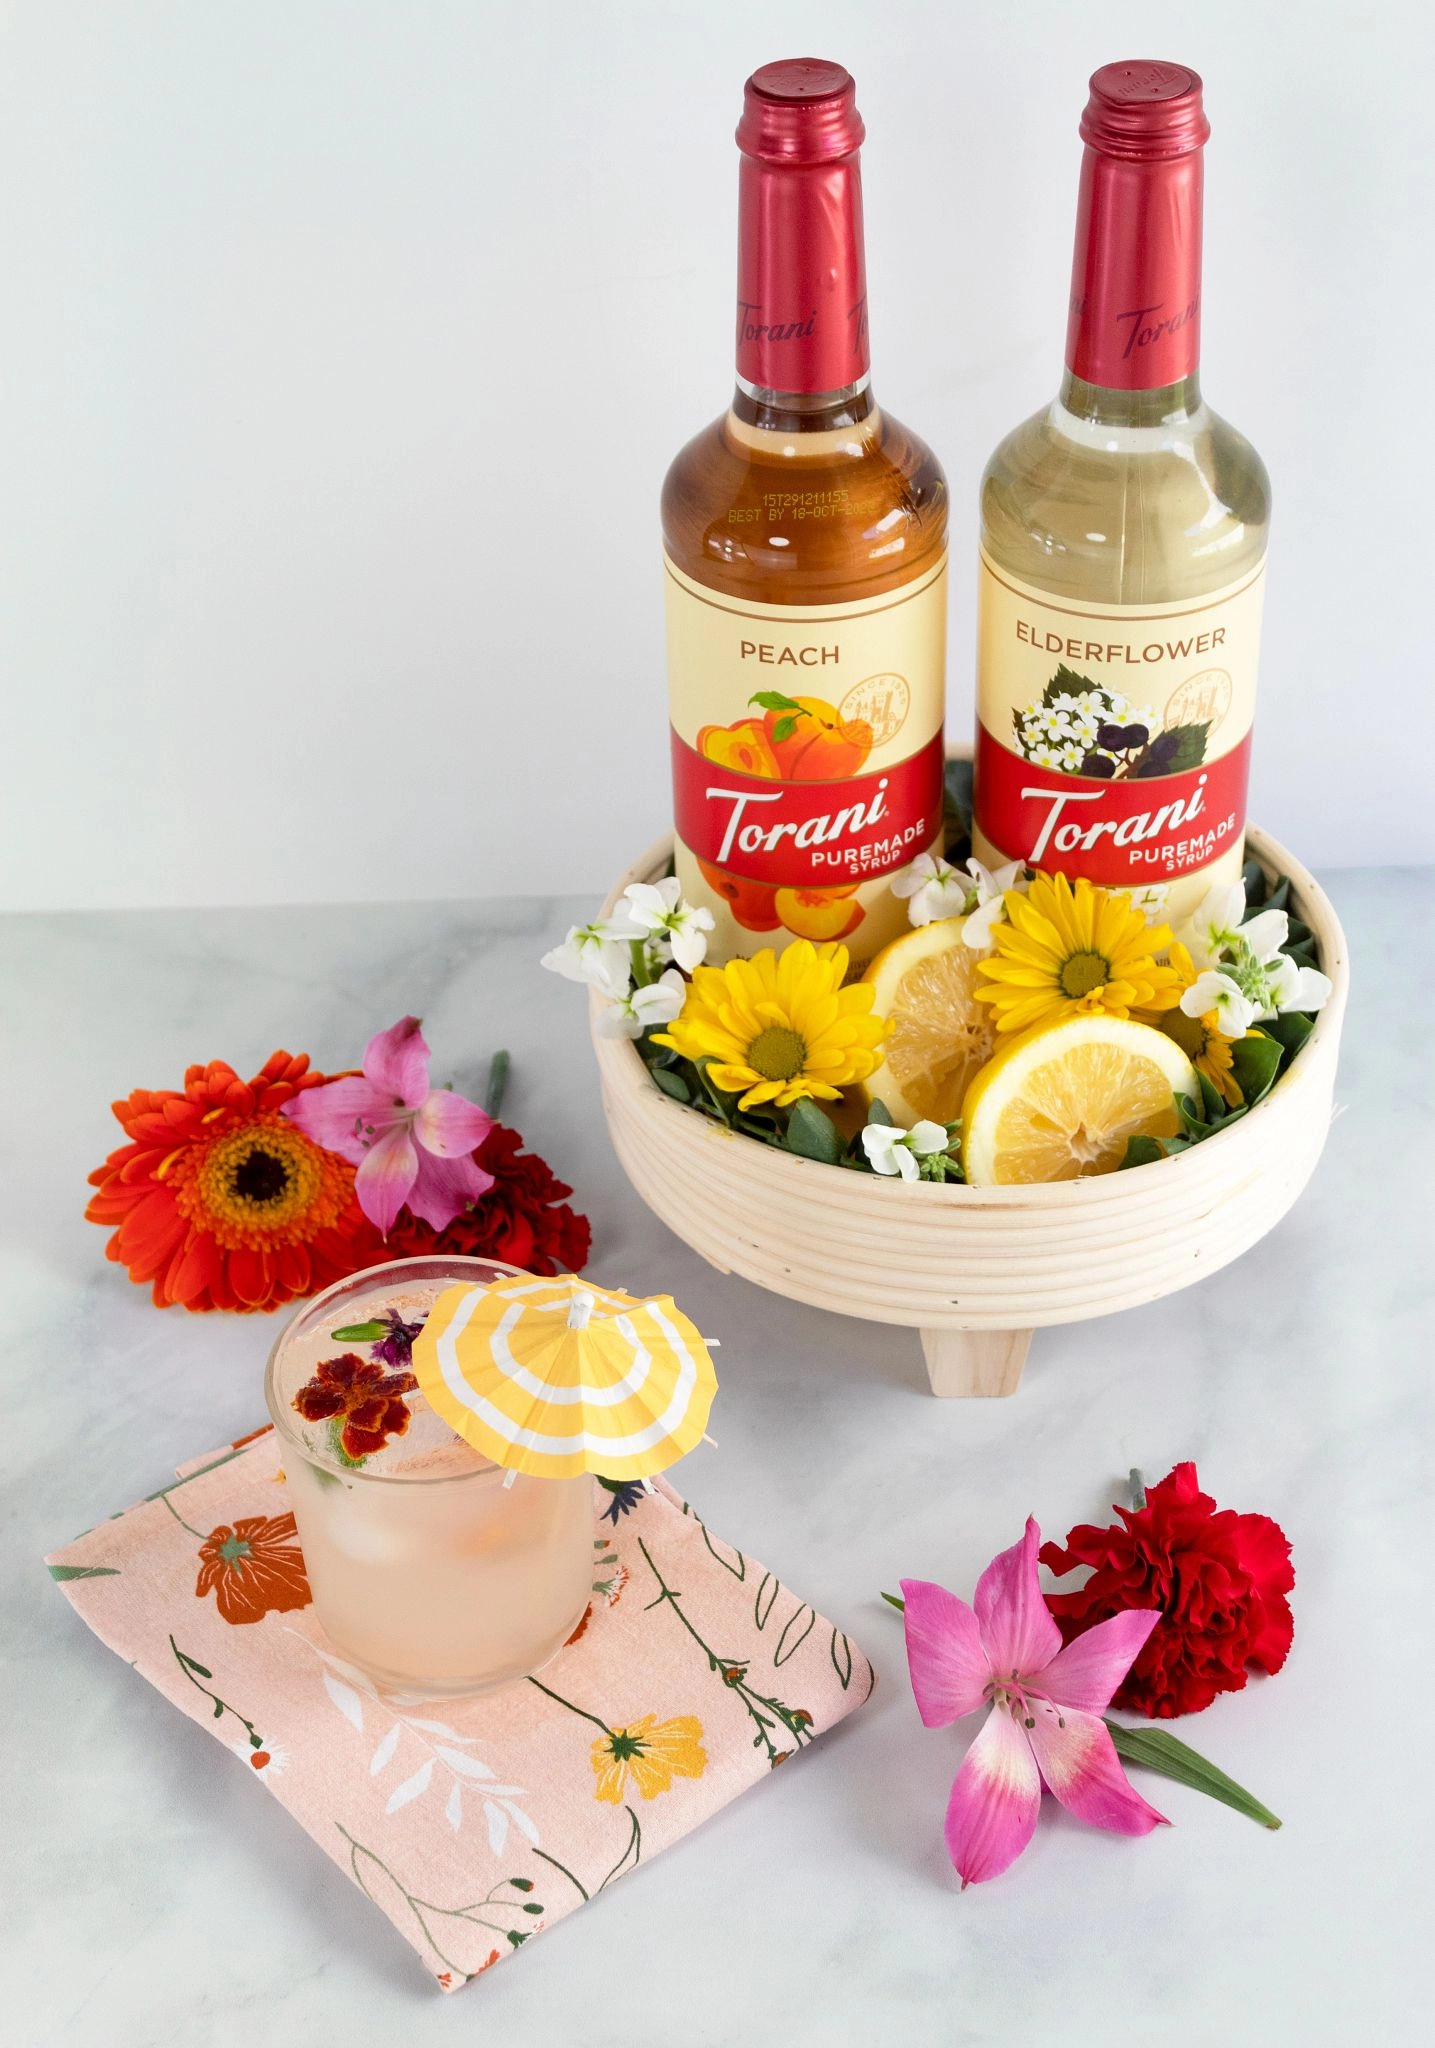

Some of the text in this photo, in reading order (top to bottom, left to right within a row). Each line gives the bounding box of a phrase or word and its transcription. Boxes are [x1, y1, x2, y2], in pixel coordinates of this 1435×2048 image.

[738, 301, 817, 346] Torani
[728, 509, 762, 523] BEST
[769, 508, 785, 521] BY
[762, 490, 849, 507] 15T291211155
[740, 640, 840, 666] PEACH
[1016, 619, 1226, 664] ELDERFLOWER
[706, 778, 889, 862] Torani
[1021, 773, 1208, 862] Torani
[1129, 812, 1236, 864] PUREMADE
[811, 818, 926, 867] PUREMADE
[849, 849, 901, 875] SYRUP
[1165, 844, 1214, 872] SYRUP
